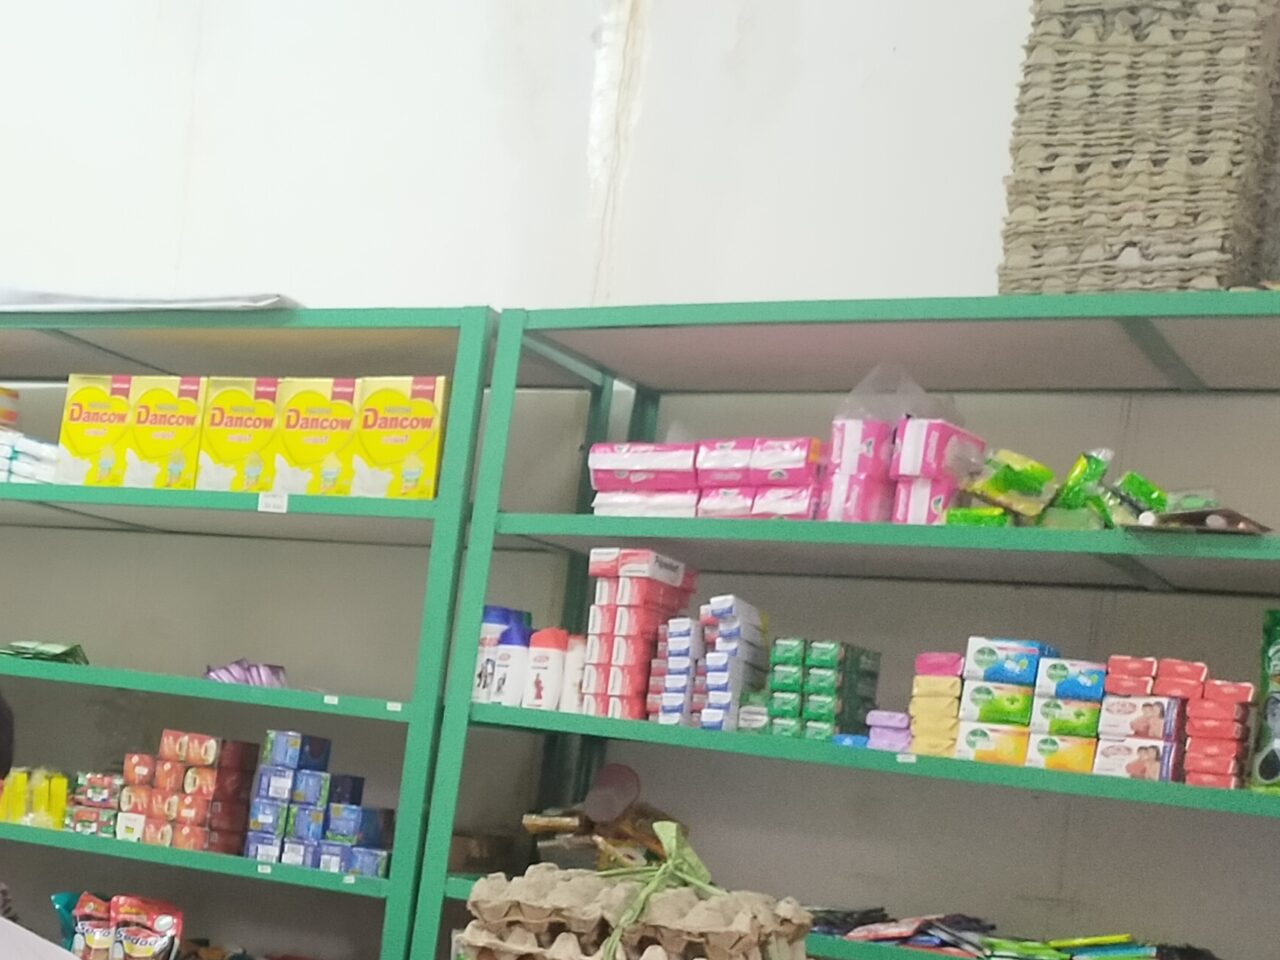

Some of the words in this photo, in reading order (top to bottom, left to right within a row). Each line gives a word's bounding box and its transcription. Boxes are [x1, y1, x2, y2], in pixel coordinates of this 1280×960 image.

[69, 403, 128, 423] Dancow
[136, 405, 198, 426] Dancow
[209, 407, 274, 429] Dancow
[285, 408, 352, 430] Dancow
[362, 408, 433, 430] Dancow
